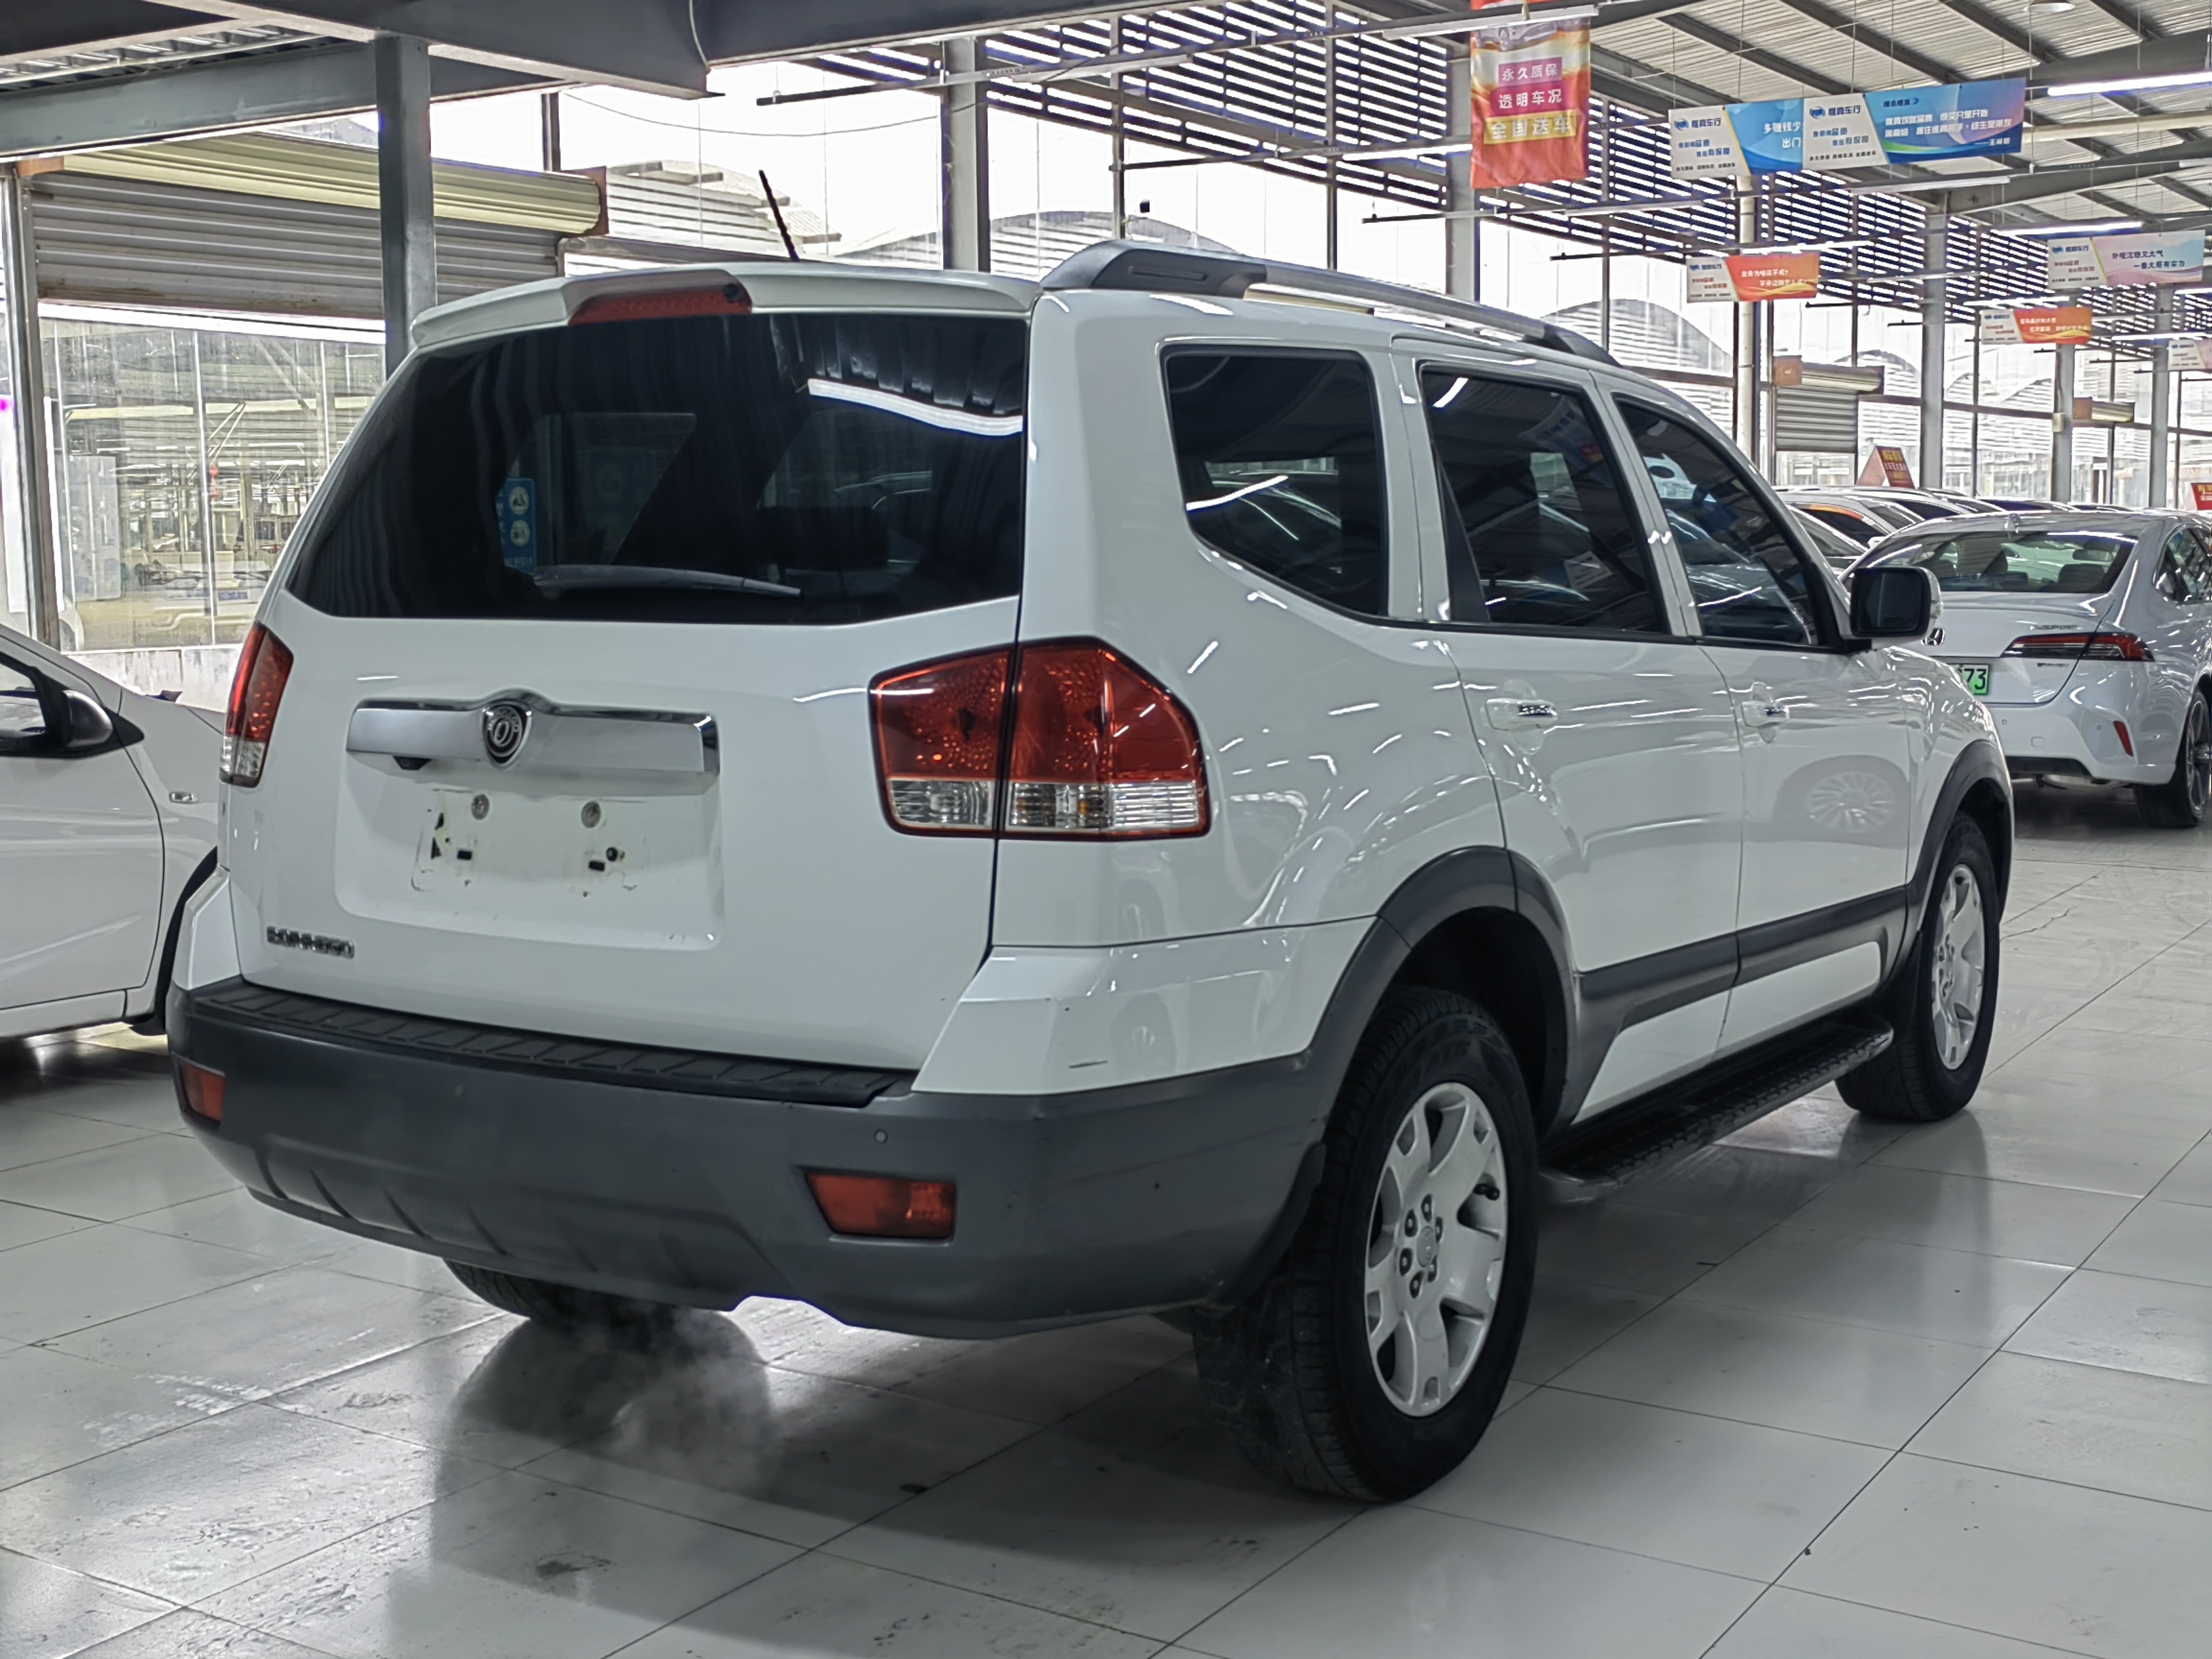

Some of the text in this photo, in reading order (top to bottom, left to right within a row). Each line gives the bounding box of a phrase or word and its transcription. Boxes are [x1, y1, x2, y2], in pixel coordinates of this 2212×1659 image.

[1502, 63, 1558, 82] 永久质保
[1499, 89, 1562, 109] 透明车况
[1491, 114, 1571, 140] 全国送车
[1957, 668, 1987, 690] 73
